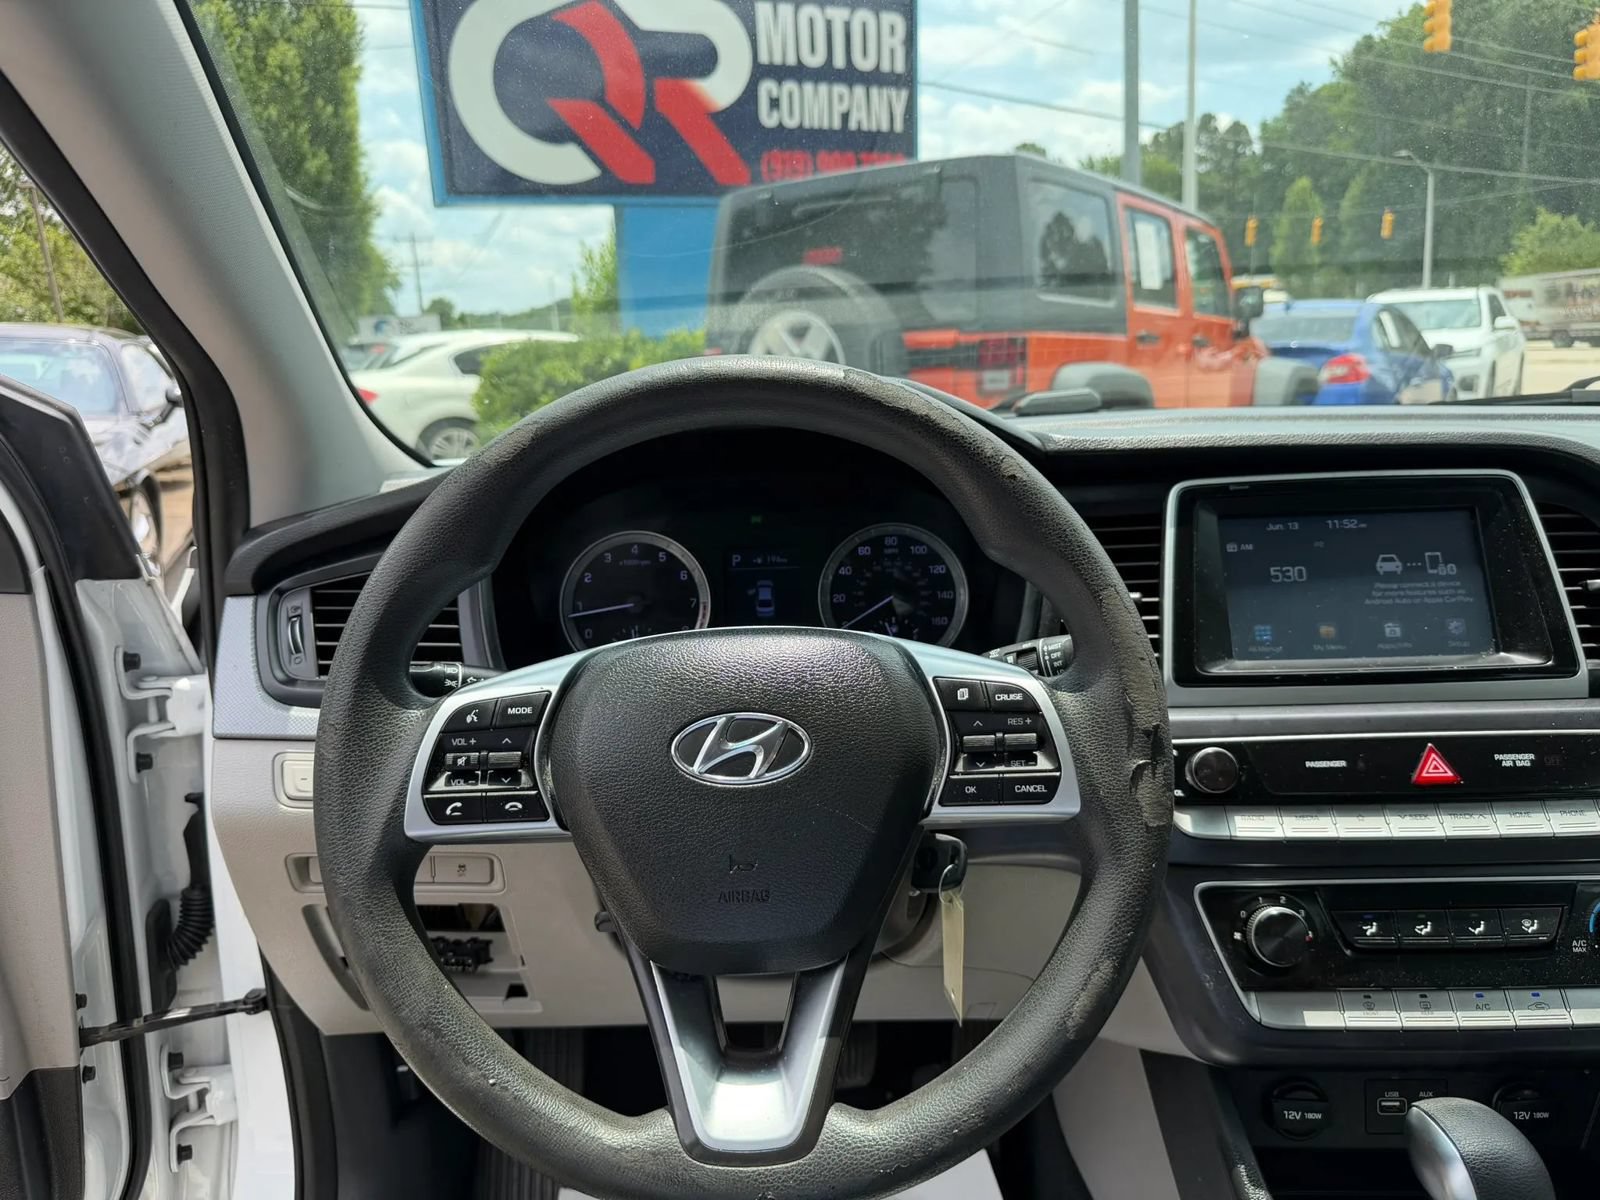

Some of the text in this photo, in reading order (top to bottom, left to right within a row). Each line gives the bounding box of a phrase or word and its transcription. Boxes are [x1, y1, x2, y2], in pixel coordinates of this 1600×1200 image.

[755, 1, 907, 74] MOTOR
[757, 78, 910, 133] COMPANY
[1288, 521, 1299, 530] 13
[1326, 519, 1357, 529] 11:52
[885, 536, 898, 545] 80
[631, 545, 639, 554] 4
[858, 546, 871, 556] 60
[910, 546, 928, 554] 100
[604, 553, 612, 563] 3
[658, 552, 667, 562] 5
[732, 554, 741, 567] P
[838, 566, 852, 576] 40
[928, 565, 946, 573] 120
[584, 572, 592, 583] 2
[680, 570, 688, 580] 6
[1270, 566, 1307, 582] 530
[833, 593, 846, 603] 20
[937, 590, 954, 600] 140
[690, 599, 697, 608] 7
[1050, 651, 1061, 659] OFF
[995, 693, 1023, 701] CRUISE
[508, 707, 533, 715] MODE
[1007, 718, 1023, 726] RES
[451, 738, 467, 746] VOL
[1494, 753, 1535, 761] PASSENGER
[1305, 760, 1347, 768] PASSENGER
[451, 779, 465, 787] VOL
[965, 786, 977, 794] OK
[1015, 785, 1048, 793] CANCEL
[1508, 811, 1532, 819] HOME
[1559, 809, 1586, 817] PHONE
[718, 889, 770, 903] AIRBAG
[1279, 896, 1287, 904] 2
[1240, 910, 1247, 918] 0
[1298, 909, 1305, 917] 3
[1475, 1003, 1491, 1011] A/C
[1283, 1110, 1302, 1120] 12V
[1513, 1111, 1531, 1120] 12V
